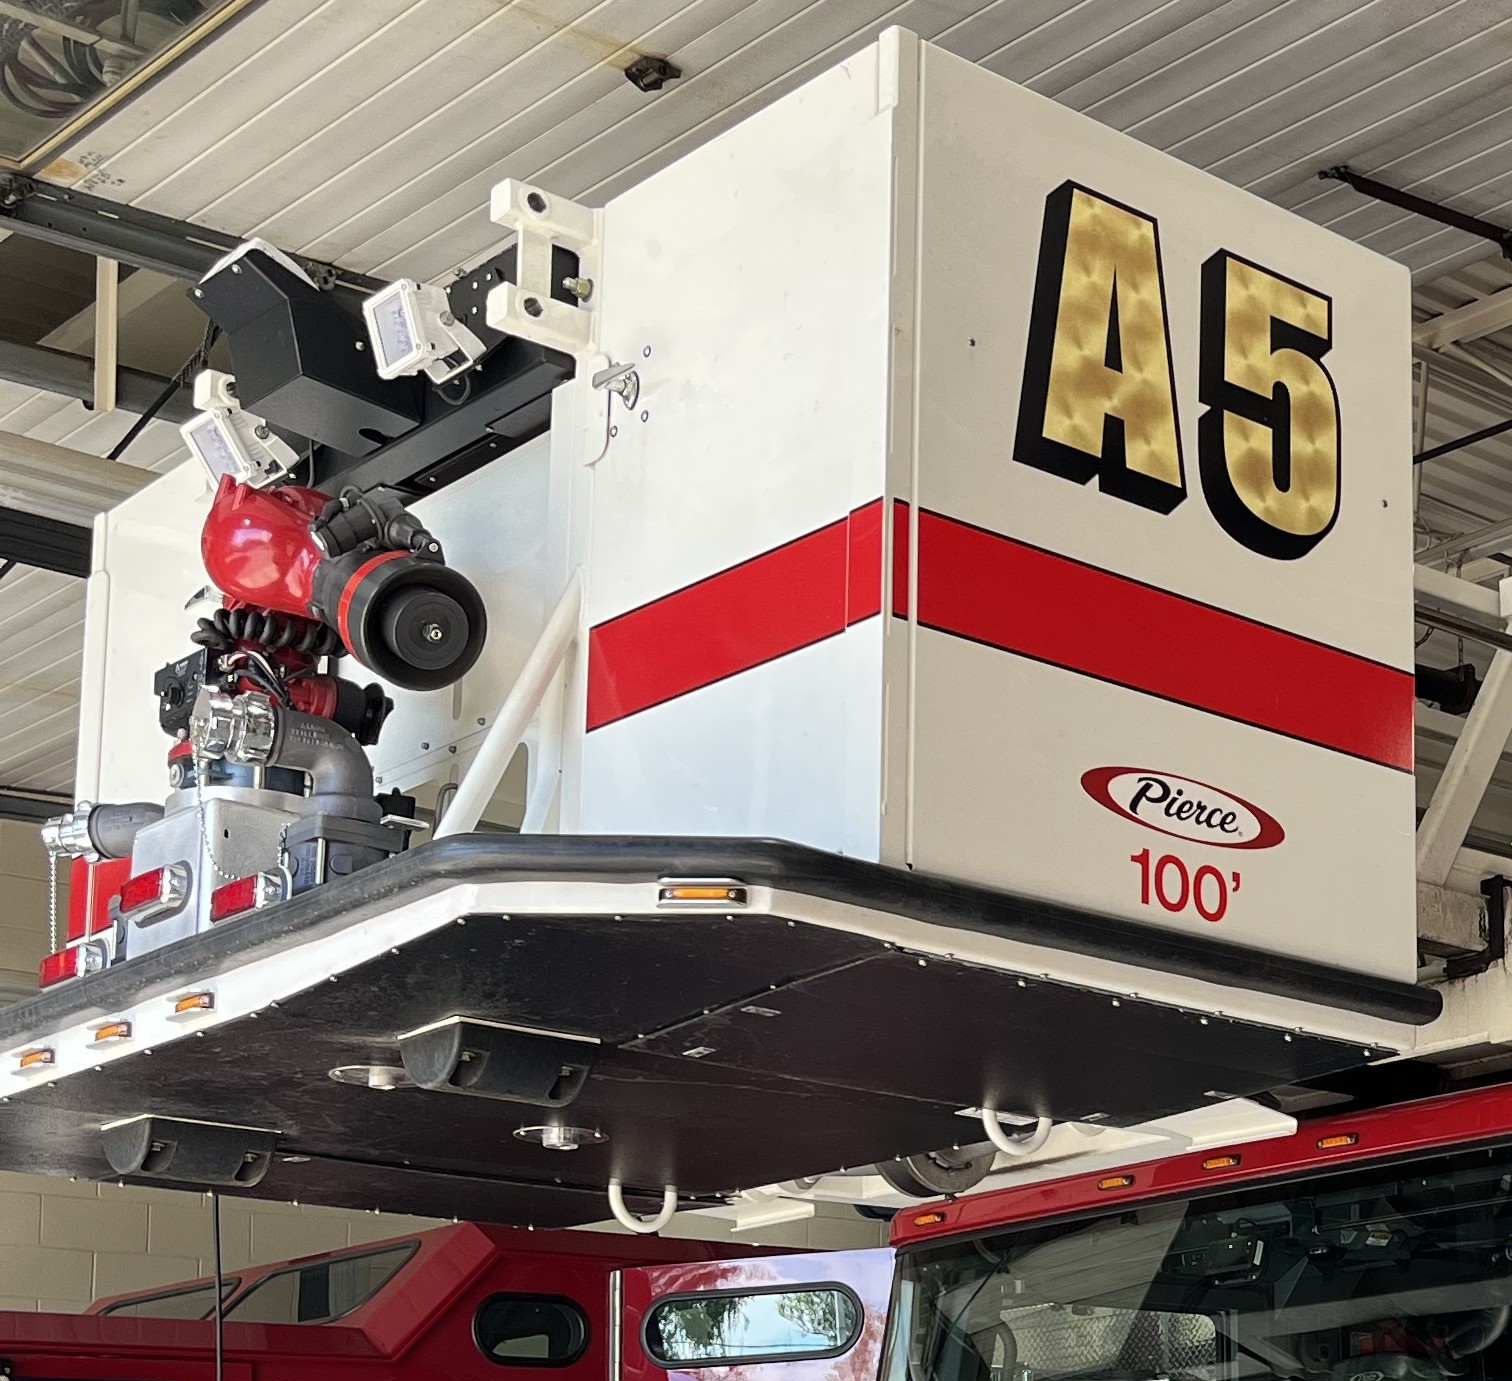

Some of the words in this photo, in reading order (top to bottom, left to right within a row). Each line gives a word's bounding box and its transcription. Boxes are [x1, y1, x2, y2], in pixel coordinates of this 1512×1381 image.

[1012, 178, 1342, 562] A5
[1128, 776, 1239, 833] Pierce
[1130, 847, 1241, 922] 100'
